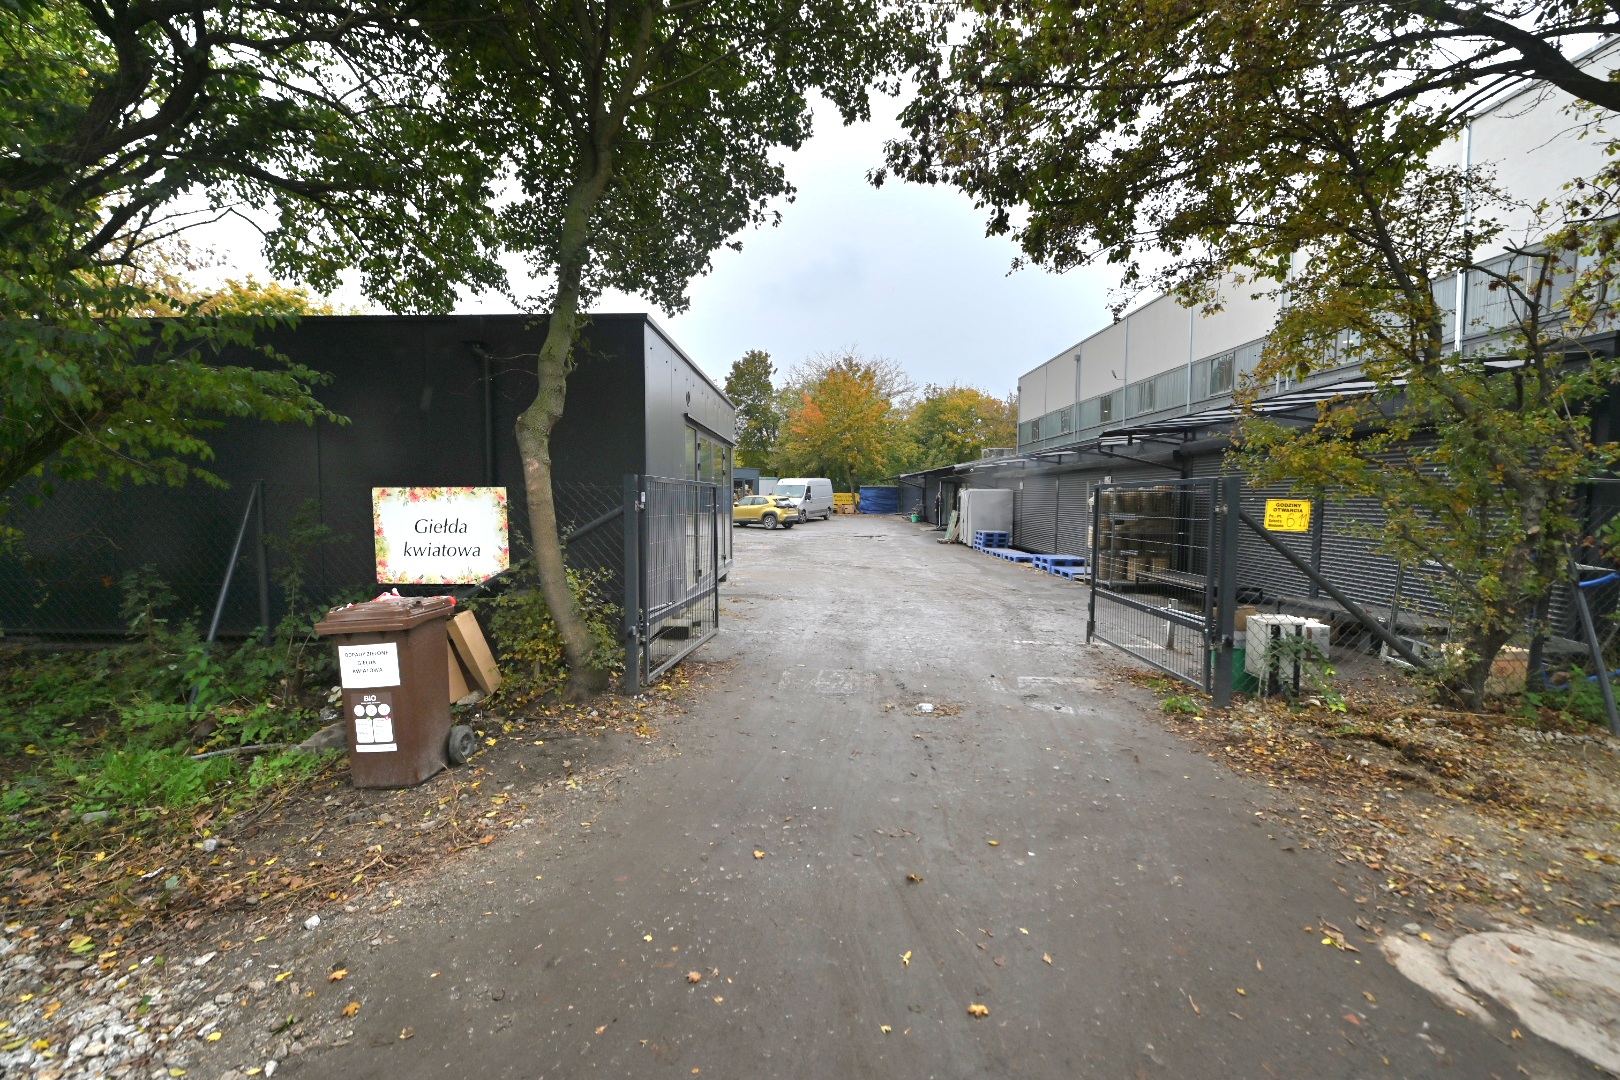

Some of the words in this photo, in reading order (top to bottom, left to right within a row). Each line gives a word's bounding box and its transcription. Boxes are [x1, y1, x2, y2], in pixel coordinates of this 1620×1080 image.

[414, 517, 468, 534] Giełda
[403, 541, 481, 557] kwiatowa
[363, 694, 377, 702] BIO
